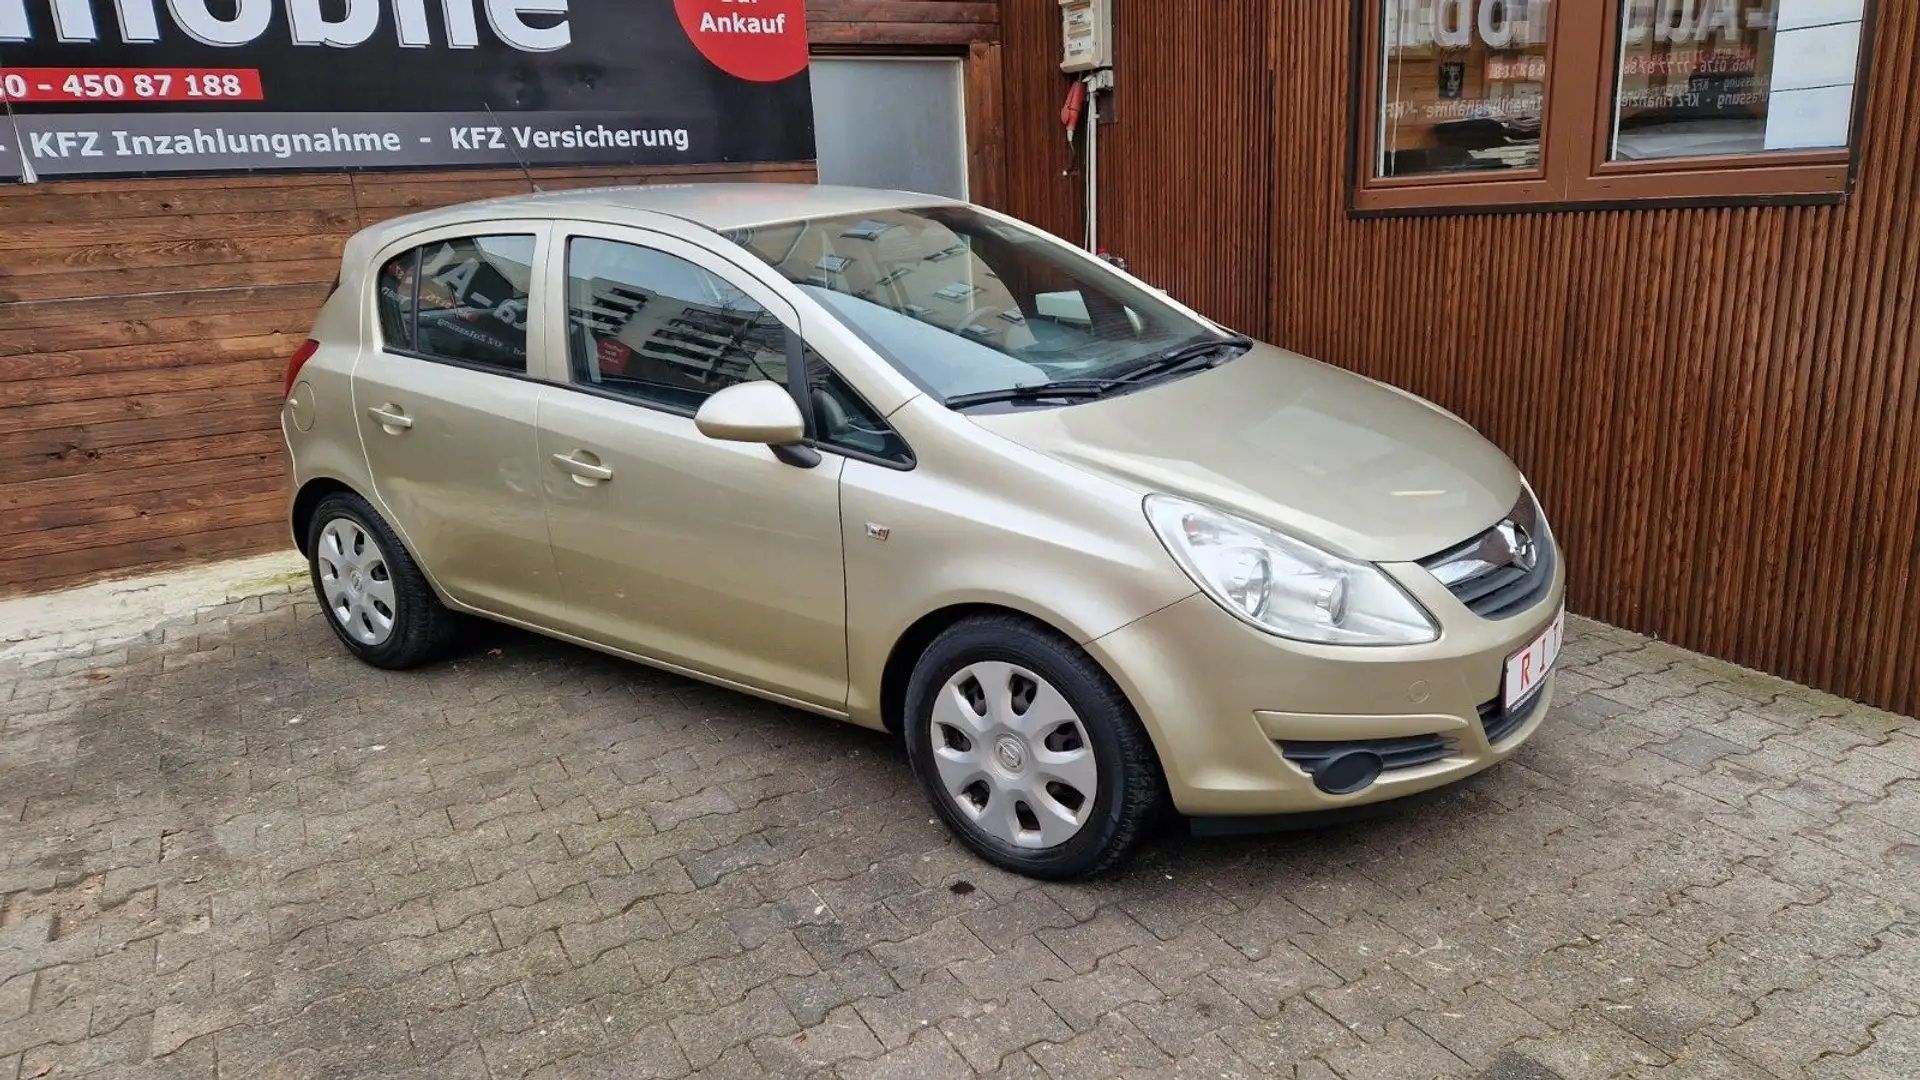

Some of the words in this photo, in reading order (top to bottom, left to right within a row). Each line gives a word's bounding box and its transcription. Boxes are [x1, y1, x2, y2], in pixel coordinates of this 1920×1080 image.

[700, 12, 786, 34] Ankauf
[62, 75, 125, 98] 450
[134, 74, 172, 97] 87
[184, 75, 242, 97] 188
[29, 132, 103, 158] KFZ
[112, 128, 402, 159] Inzahlungnahme
[450, 127, 505, 150] KFZ
[512, 125, 689, 151] Versicherung
